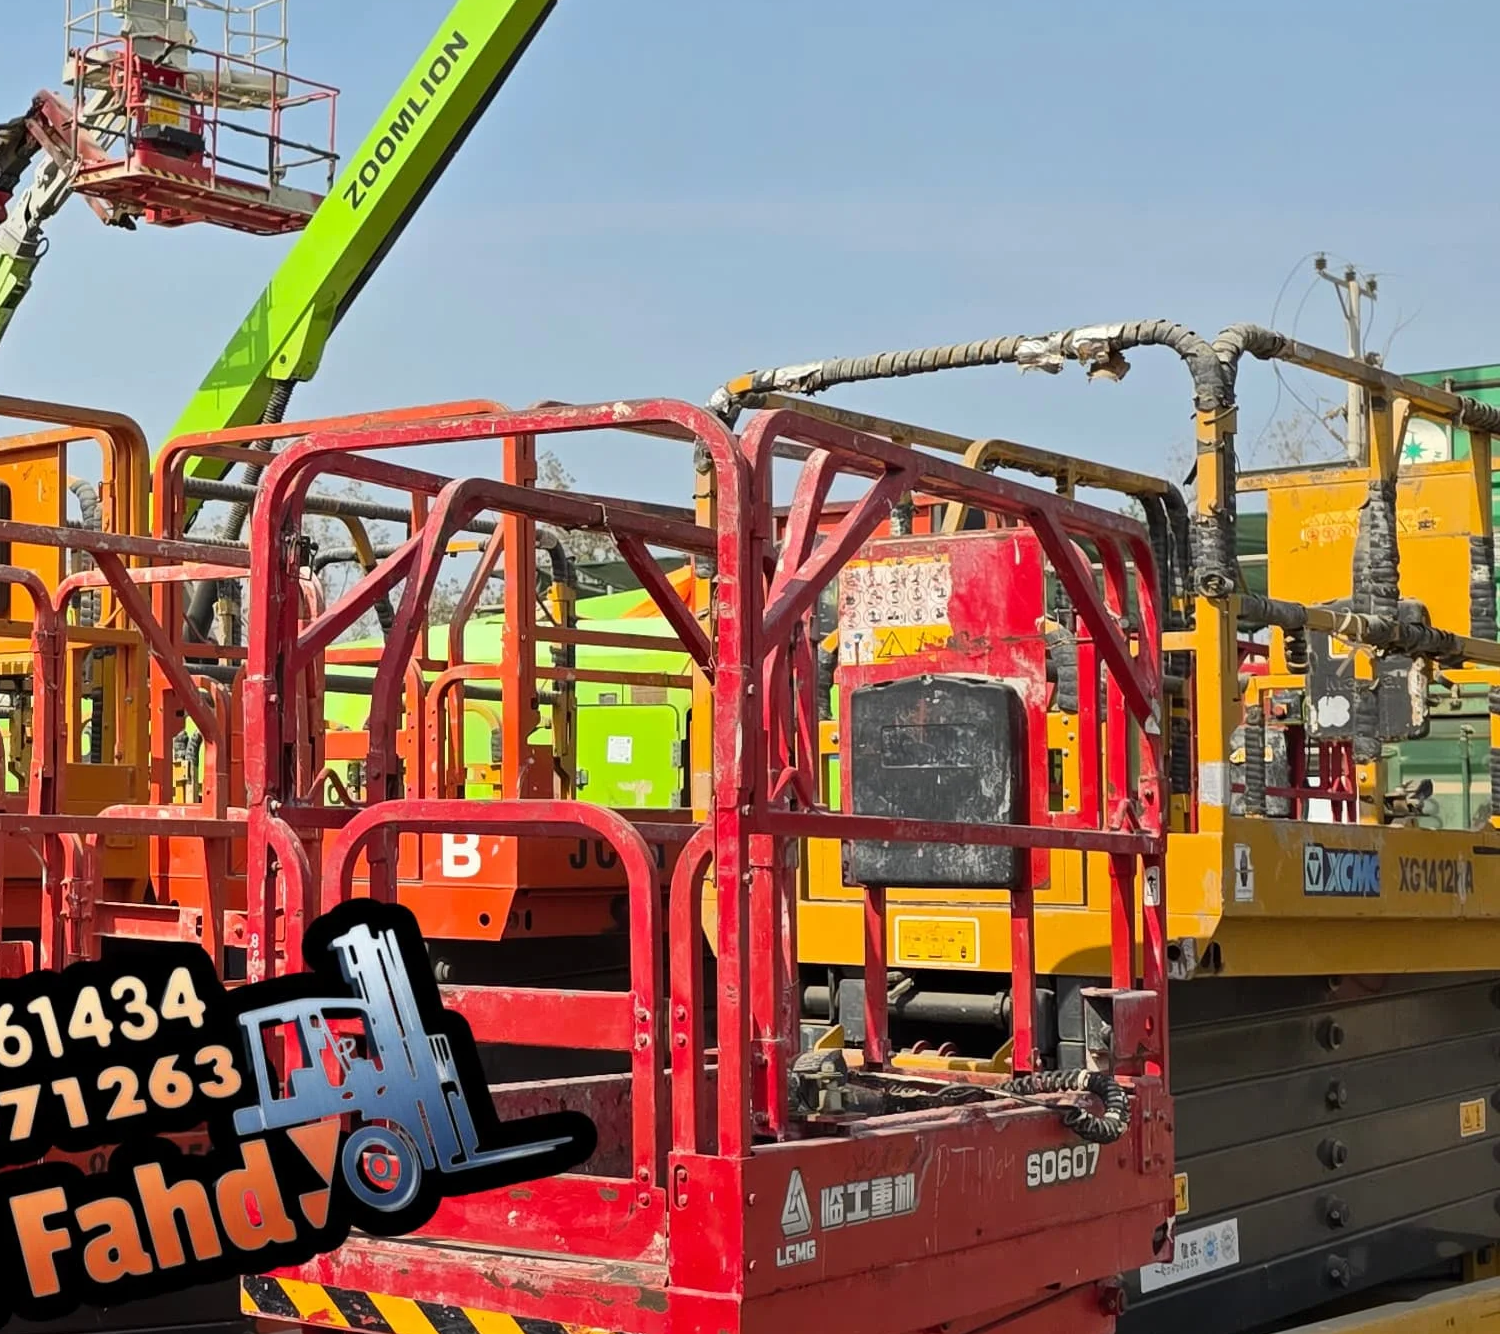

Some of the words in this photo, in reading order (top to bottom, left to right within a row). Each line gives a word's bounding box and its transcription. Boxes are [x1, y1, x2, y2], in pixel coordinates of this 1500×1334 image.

[342, 30, 469, 211] ZOOMLION
[440, 833, 482, 878] B
[820, 1172, 916, 1230] 临工重机
